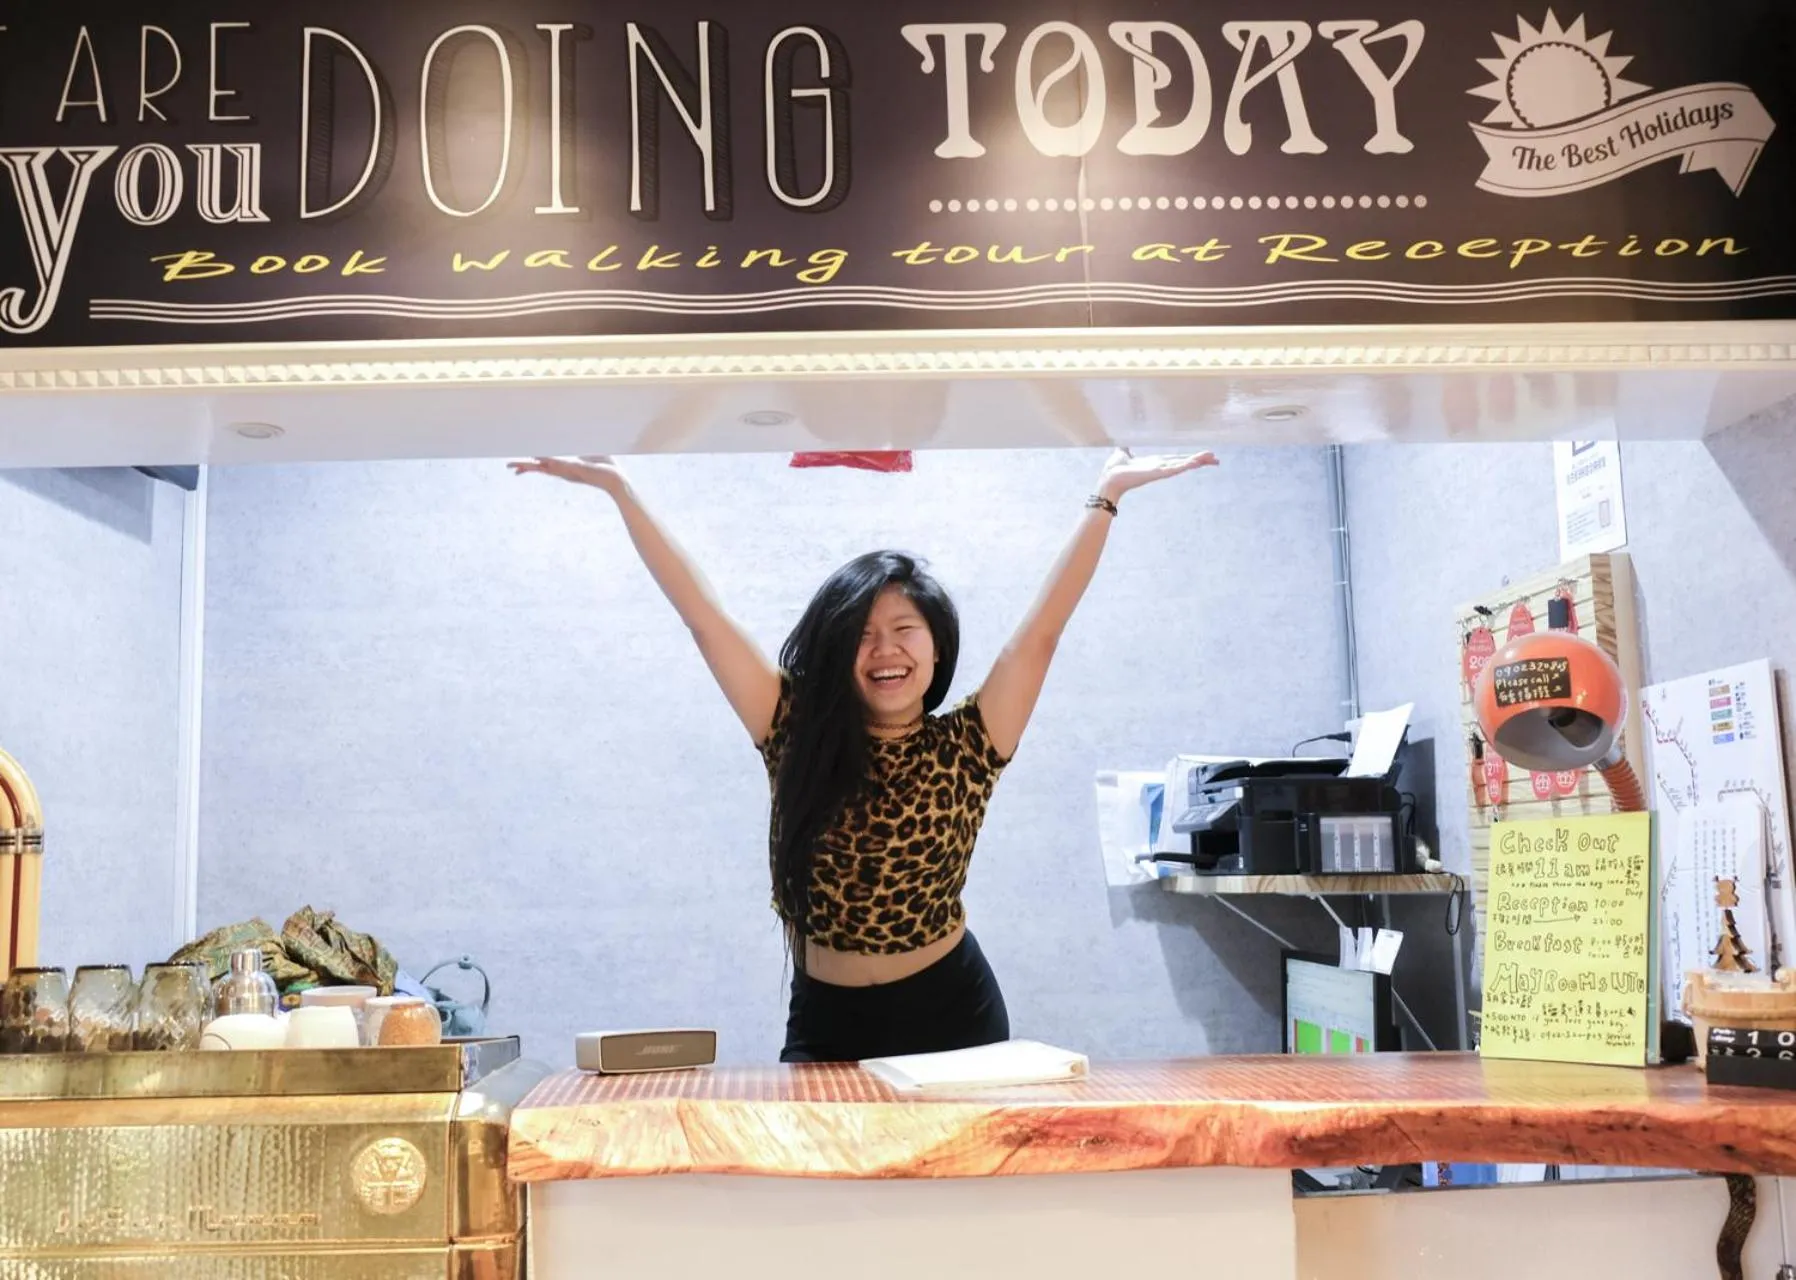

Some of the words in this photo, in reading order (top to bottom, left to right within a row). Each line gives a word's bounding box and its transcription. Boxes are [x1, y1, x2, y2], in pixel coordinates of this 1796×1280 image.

[55, 22, 251, 122] ARE
[301, 20, 836, 218] DOING
[901, 18, 1426, 159] TODAY
[1512, 145, 1557, 172] The
[1561, 136, 1619, 169] Best
[1620, 101, 1734, 150] Holidays
[0, 142, 271, 334] you
[150, 250, 388, 282] Book
[452, 244, 849, 284] walking
[891, 241, 1095, 265] tour
[1131, 238, 1233, 263] at
[1257, 233, 1748, 269] Reception
